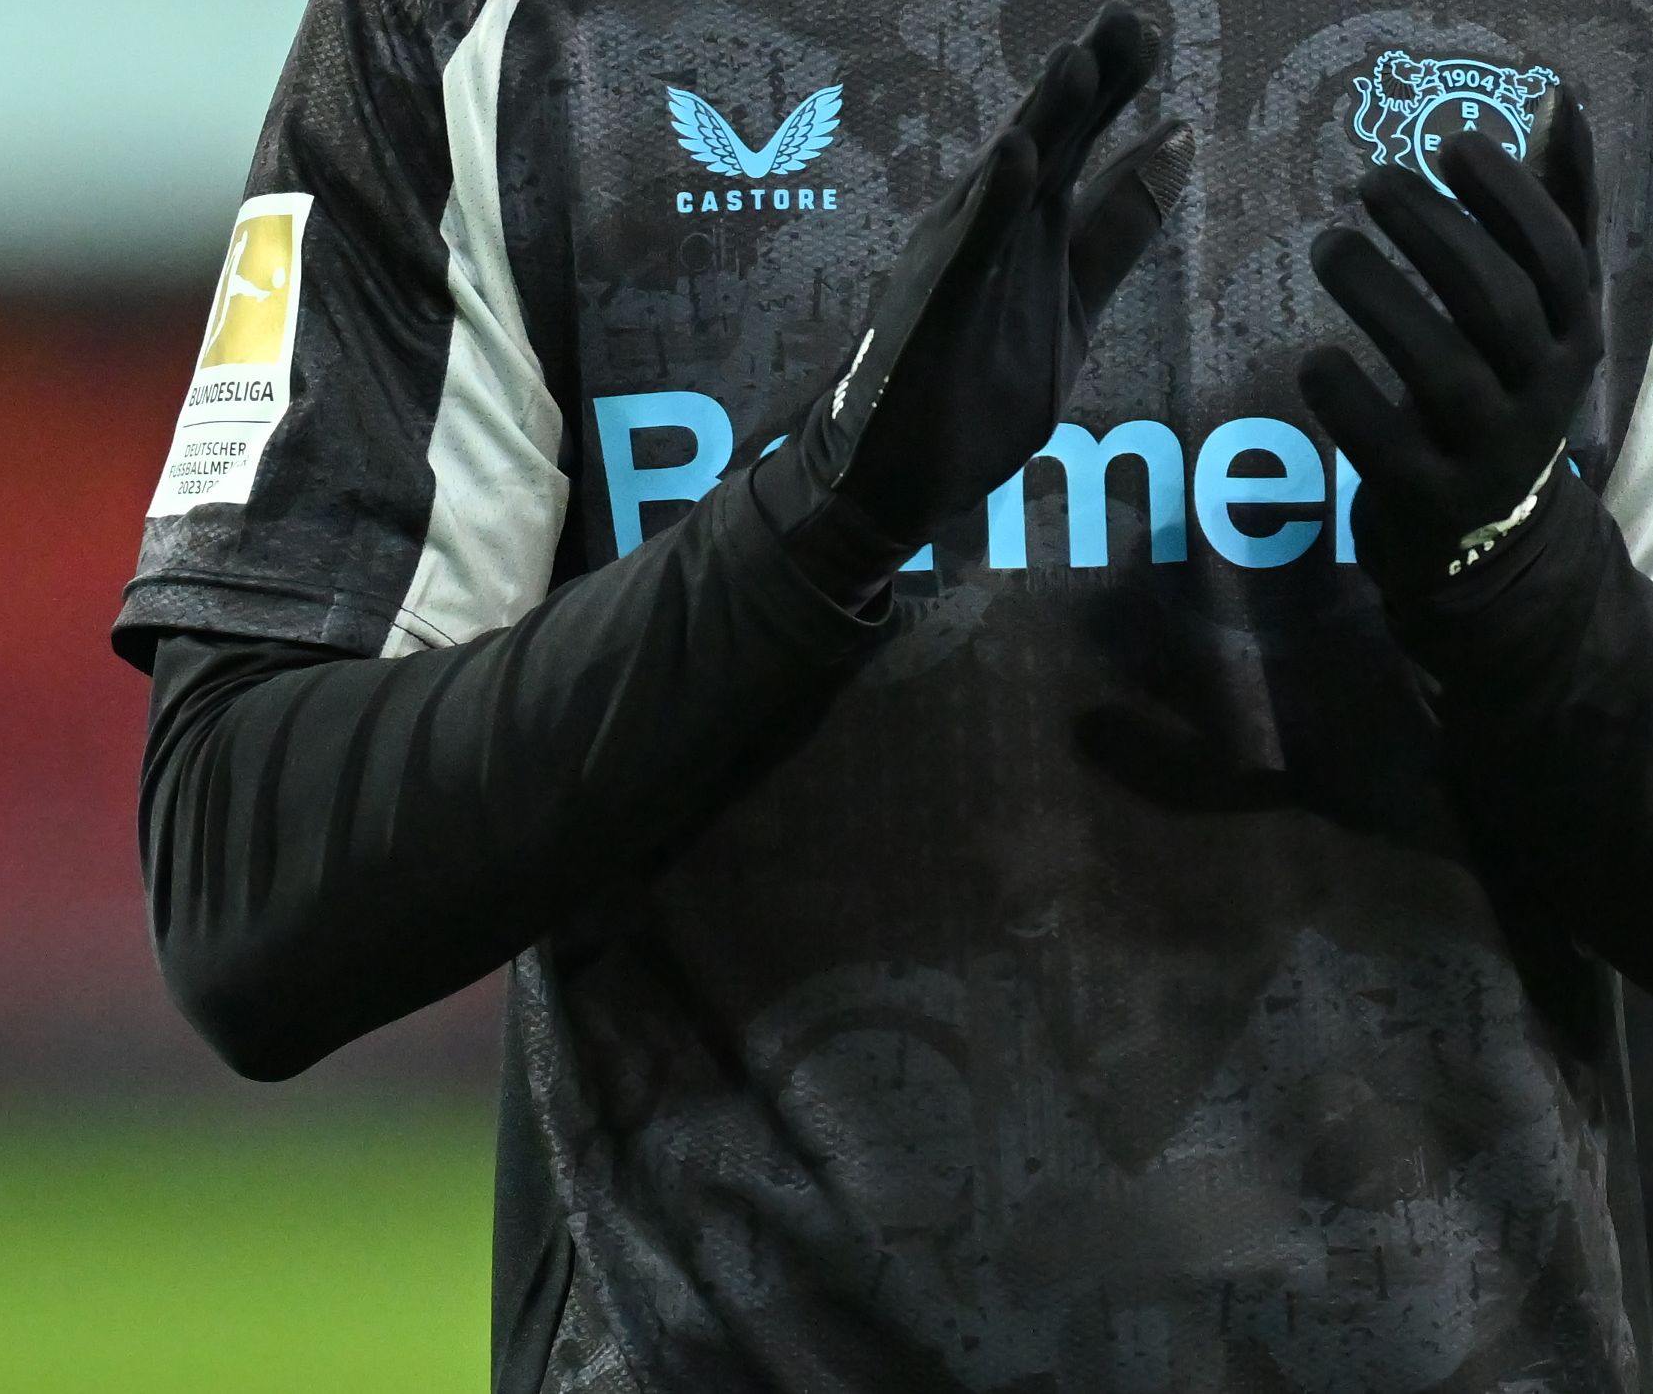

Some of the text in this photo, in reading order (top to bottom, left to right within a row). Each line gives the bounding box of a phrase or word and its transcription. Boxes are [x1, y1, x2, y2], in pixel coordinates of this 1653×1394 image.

[1442, 69, 1495, 92] 1904
[676, 189, 837, 214] CASTORE
[189, 381, 274, 407] BUNDESLIGA
[184, 442, 247, 458] DEUTSCHER
[178, 480, 220, 495] 2023/2
